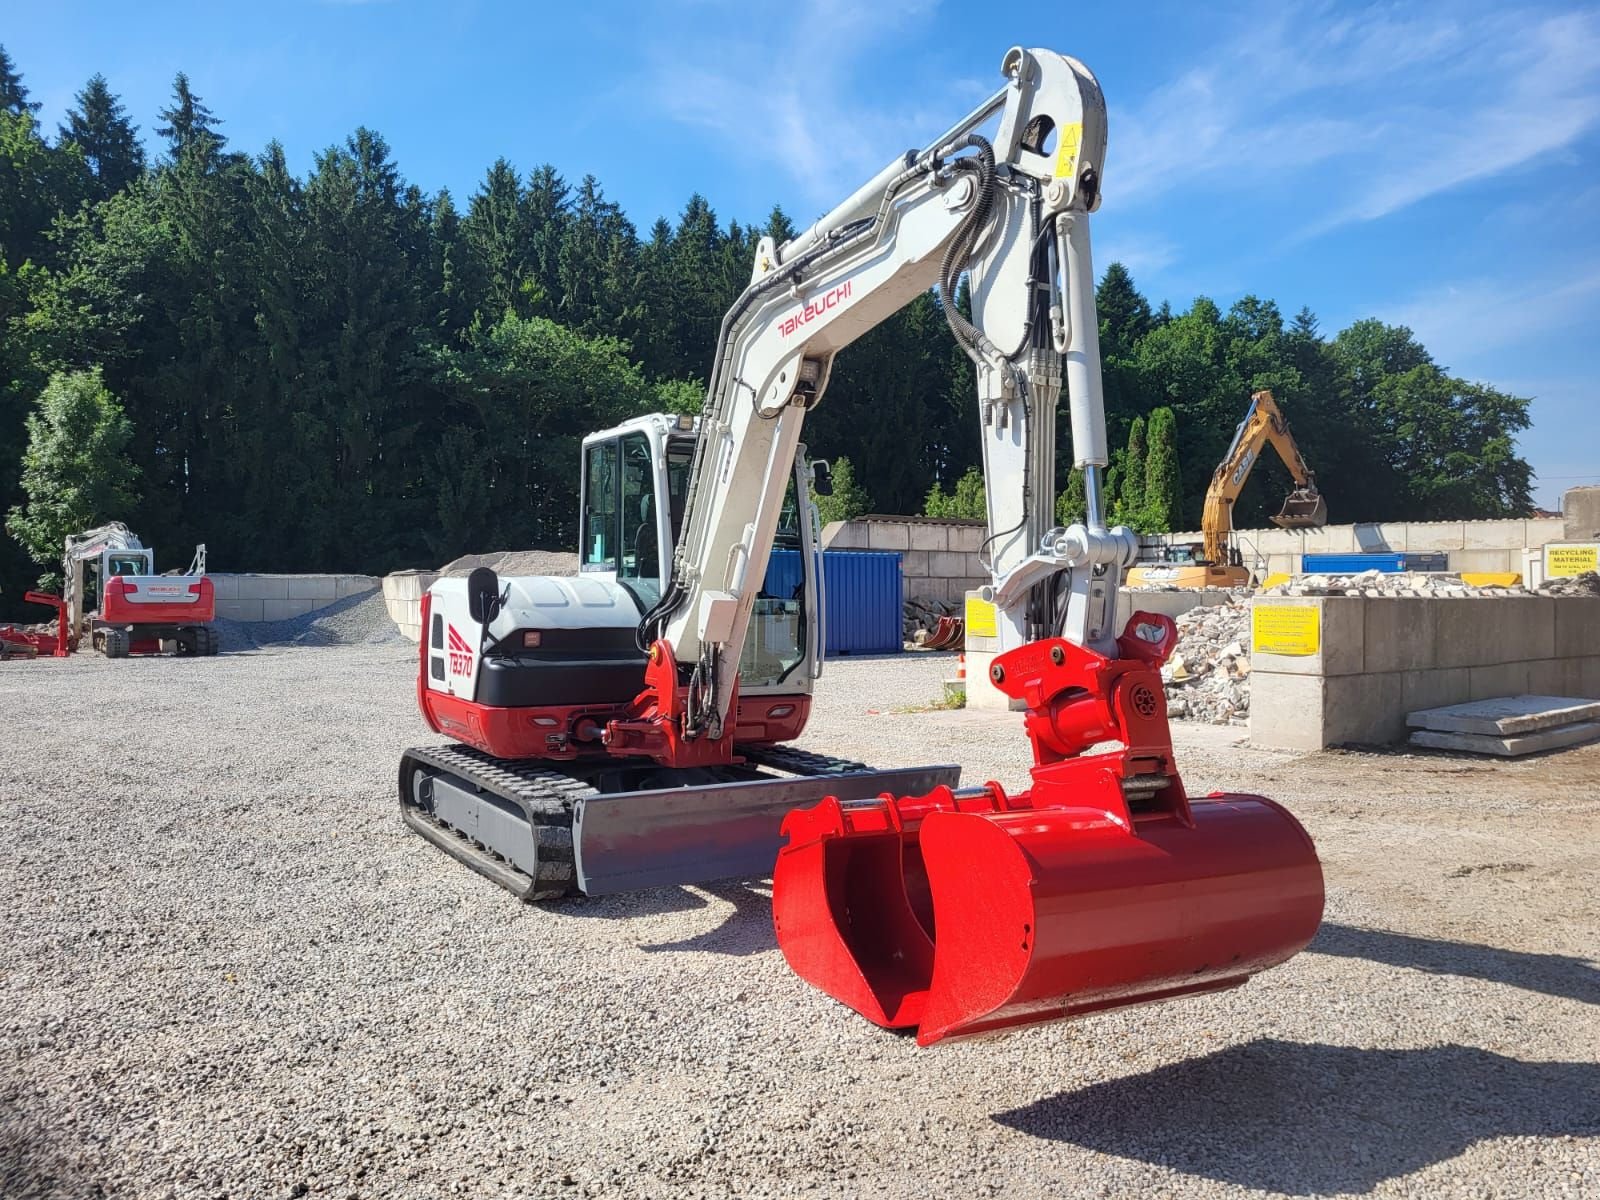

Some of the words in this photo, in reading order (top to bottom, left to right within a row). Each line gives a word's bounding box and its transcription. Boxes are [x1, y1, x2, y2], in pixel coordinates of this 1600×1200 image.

[777, 280, 852, 337] TAKEUCHI
[1233, 449, 1254, 485] CASE
[450, 653, 473, 678] TB370
